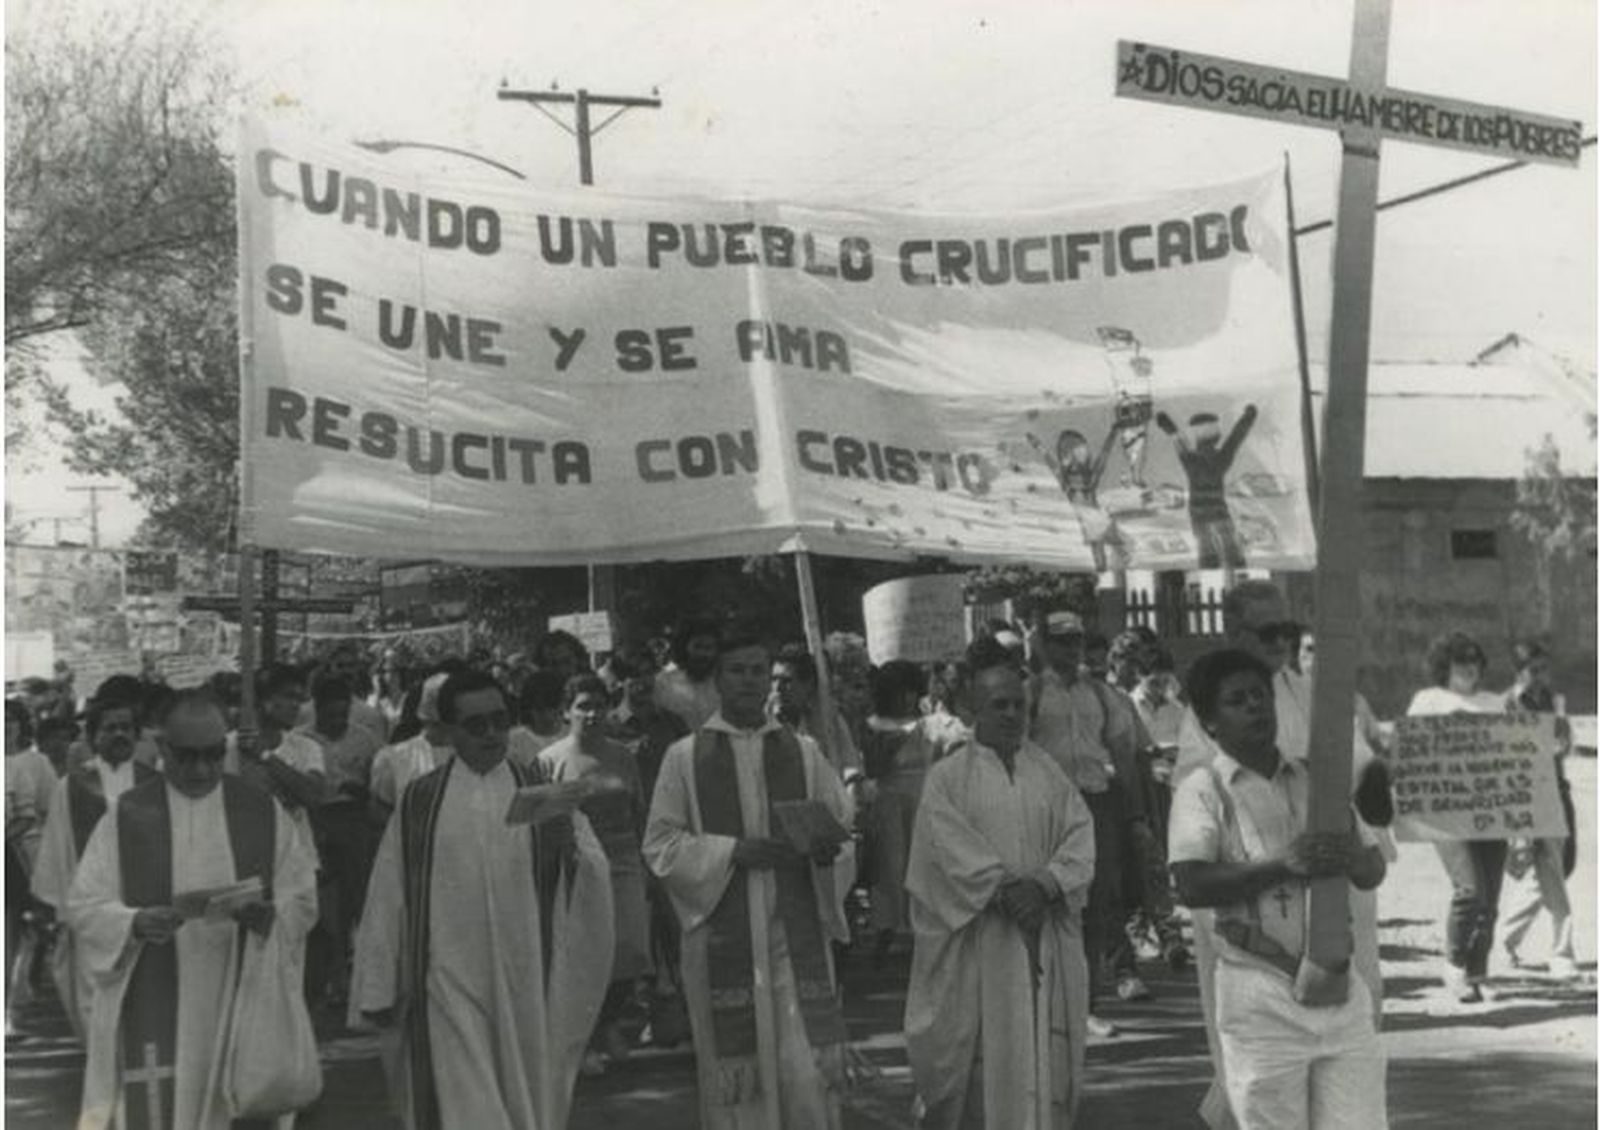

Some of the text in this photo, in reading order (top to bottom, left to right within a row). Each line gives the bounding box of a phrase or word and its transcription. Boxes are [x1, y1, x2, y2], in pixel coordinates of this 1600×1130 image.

[255, 148, 501, 256] CUANDO
[536, 214, 617, 268] UN
[647, 220, 874, 283] PUEBLO
[265, 263, 852, 375] SE UNE Y SE AMA
[265, 387, 994, 496] RESUCITA CON CRISTO
